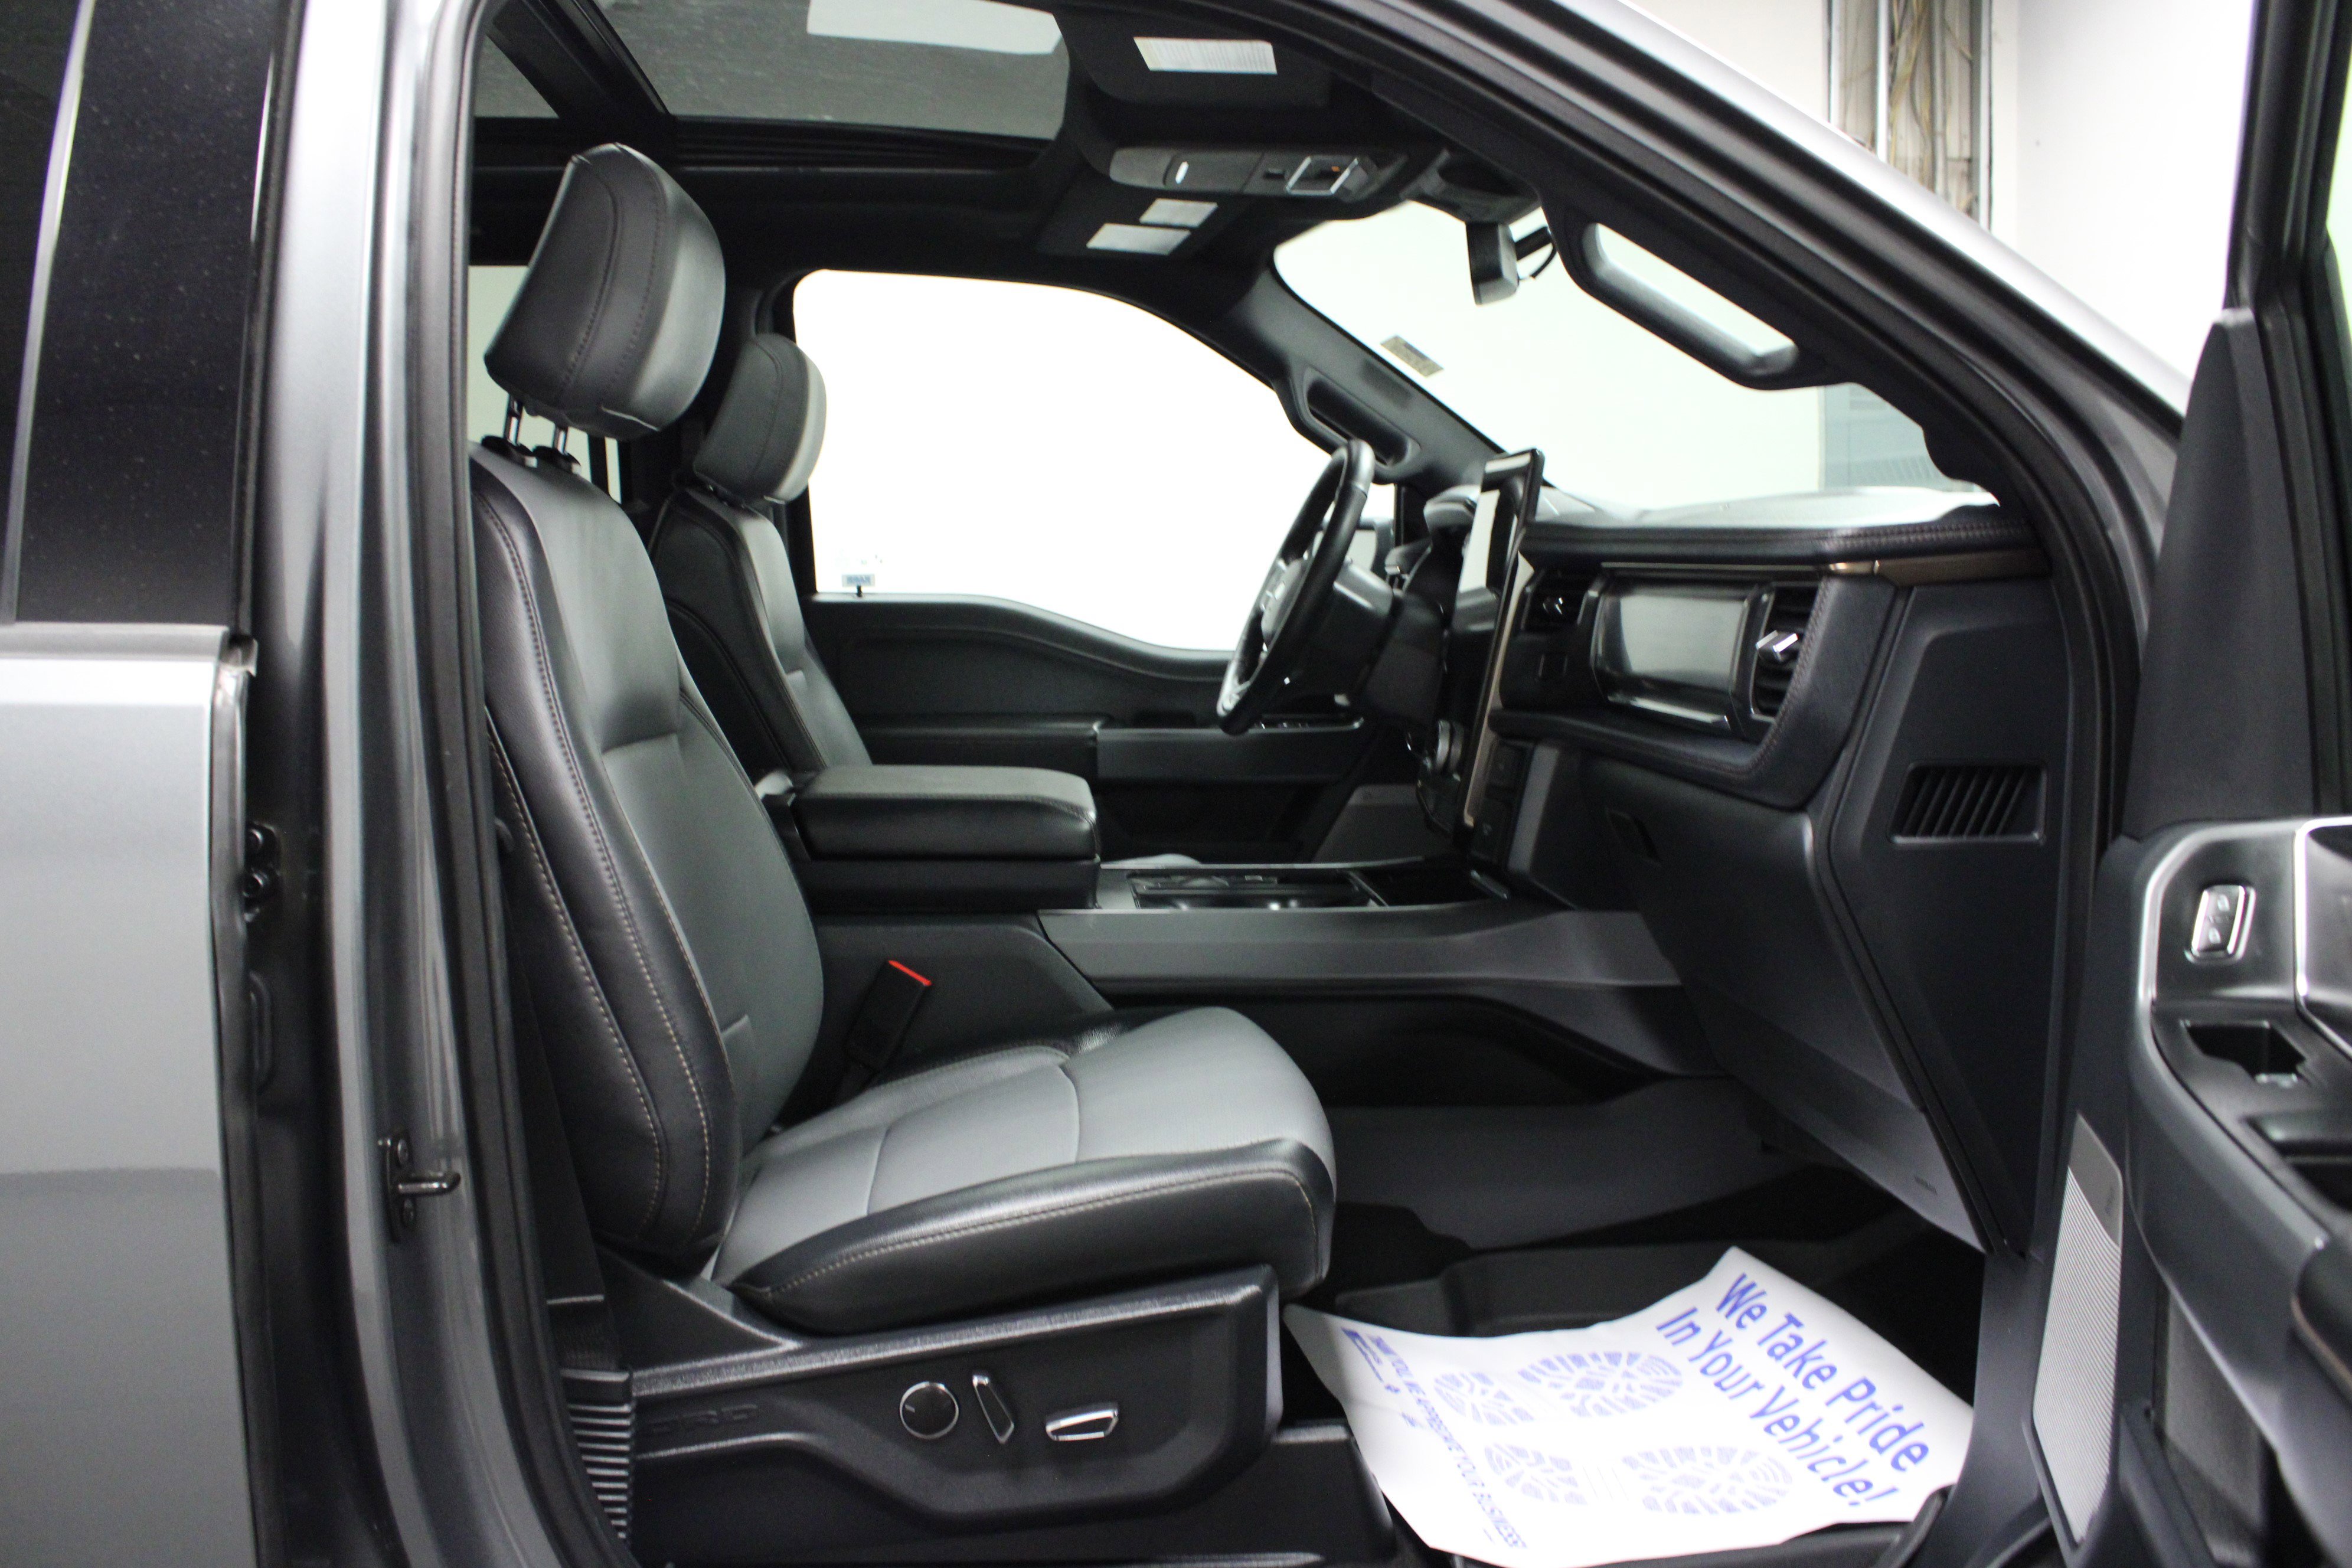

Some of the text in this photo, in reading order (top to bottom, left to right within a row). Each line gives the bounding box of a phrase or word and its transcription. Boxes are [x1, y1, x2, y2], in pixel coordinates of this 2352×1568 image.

[1655, 1306, 1900, 1507] In Your Vehicle!
[1716, 1272, 1930, 1472] We Take Pride
